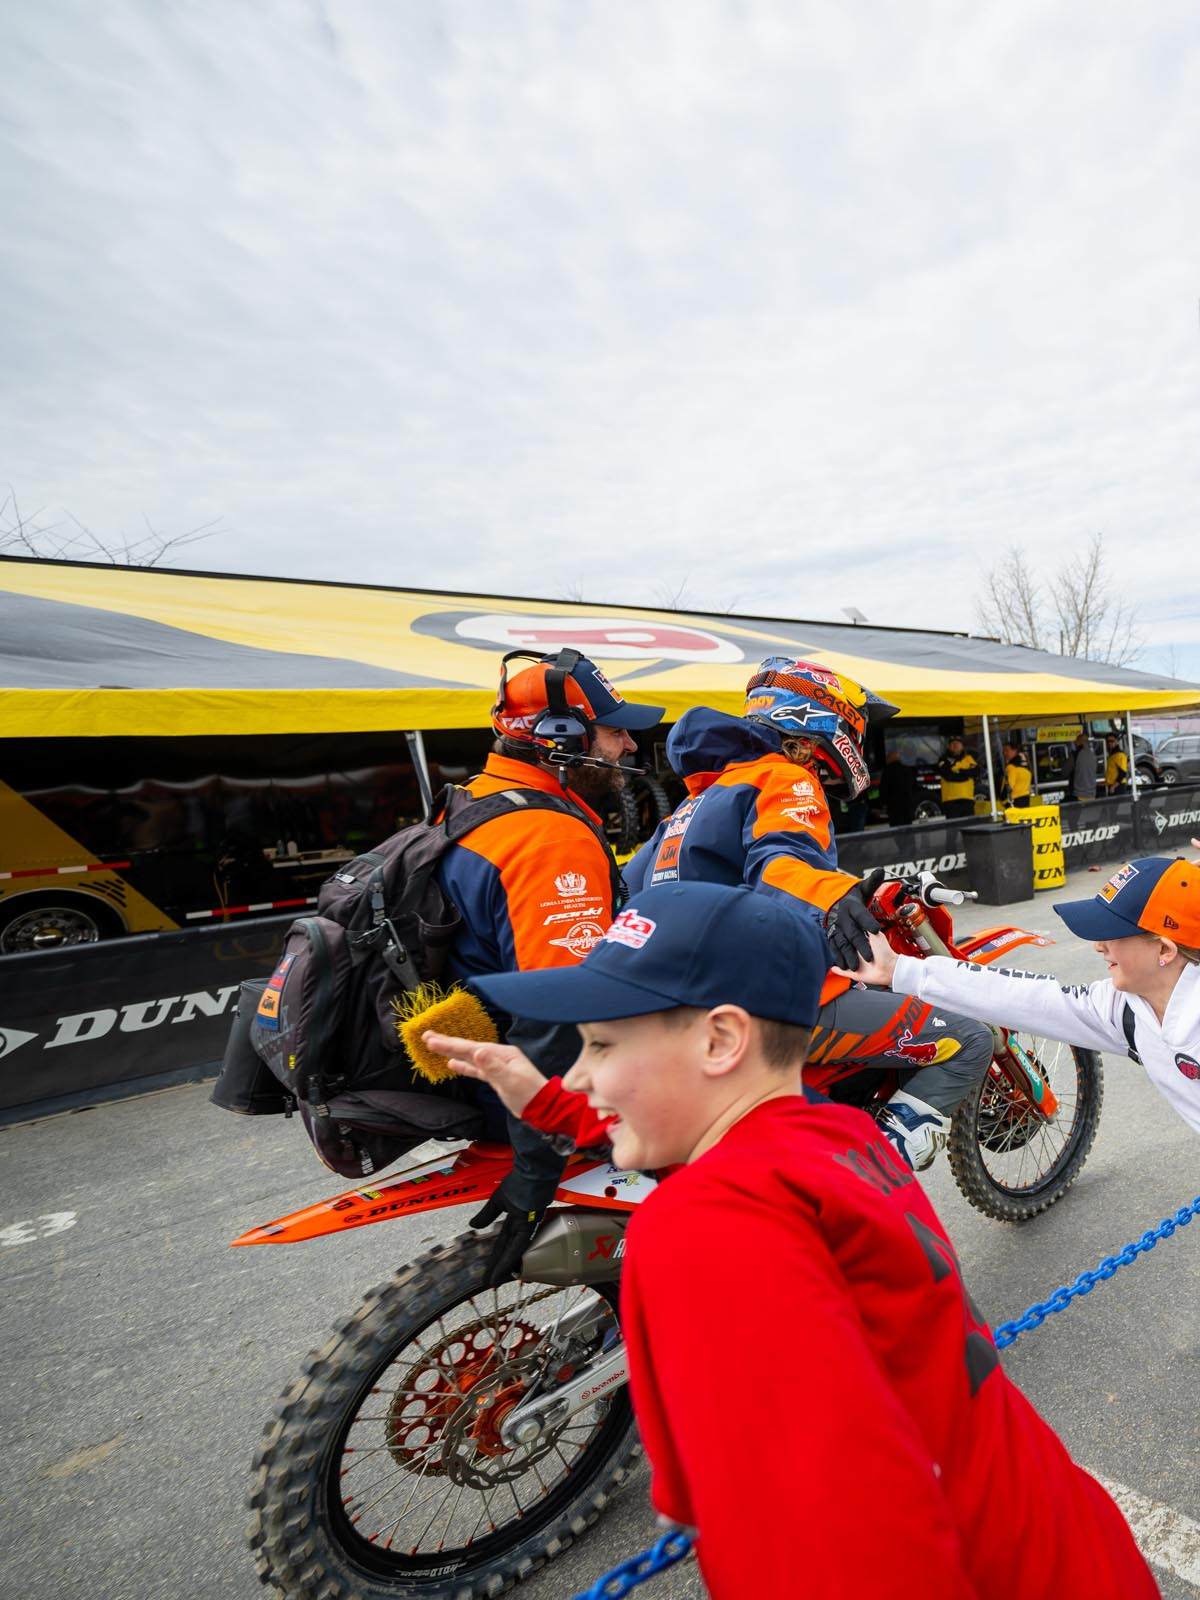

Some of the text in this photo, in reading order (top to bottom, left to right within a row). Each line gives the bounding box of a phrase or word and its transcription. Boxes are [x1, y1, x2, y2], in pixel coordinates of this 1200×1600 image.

[812, 688, 861, 726] OAKLEY
[43, 985, 239, 1049] DUN
[365, 1184, 478, 1217] DUNLOP
[592, 1369, 625, 1394] brembo
